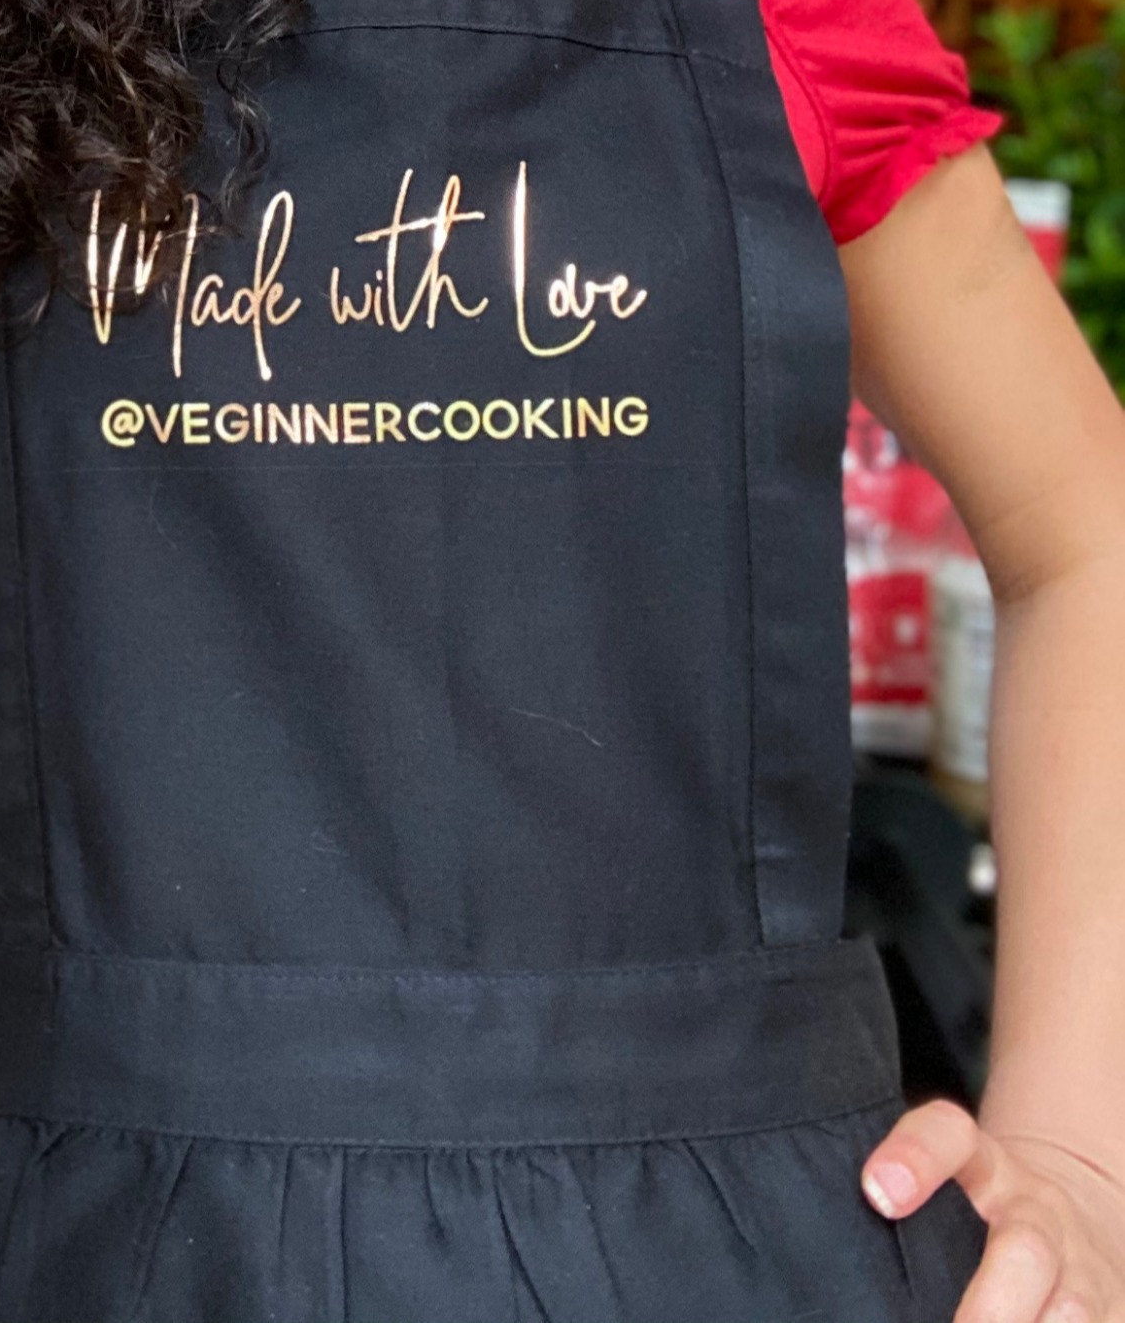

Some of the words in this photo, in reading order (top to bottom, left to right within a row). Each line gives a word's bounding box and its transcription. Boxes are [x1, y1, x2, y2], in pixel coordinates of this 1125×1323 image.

[86, 188, 302, 381] Made
[330, 168, 488, 332] with
[513, 160, 648, 358] Love
[101, 397, 649, 447] @VEGINNERCOOKING
